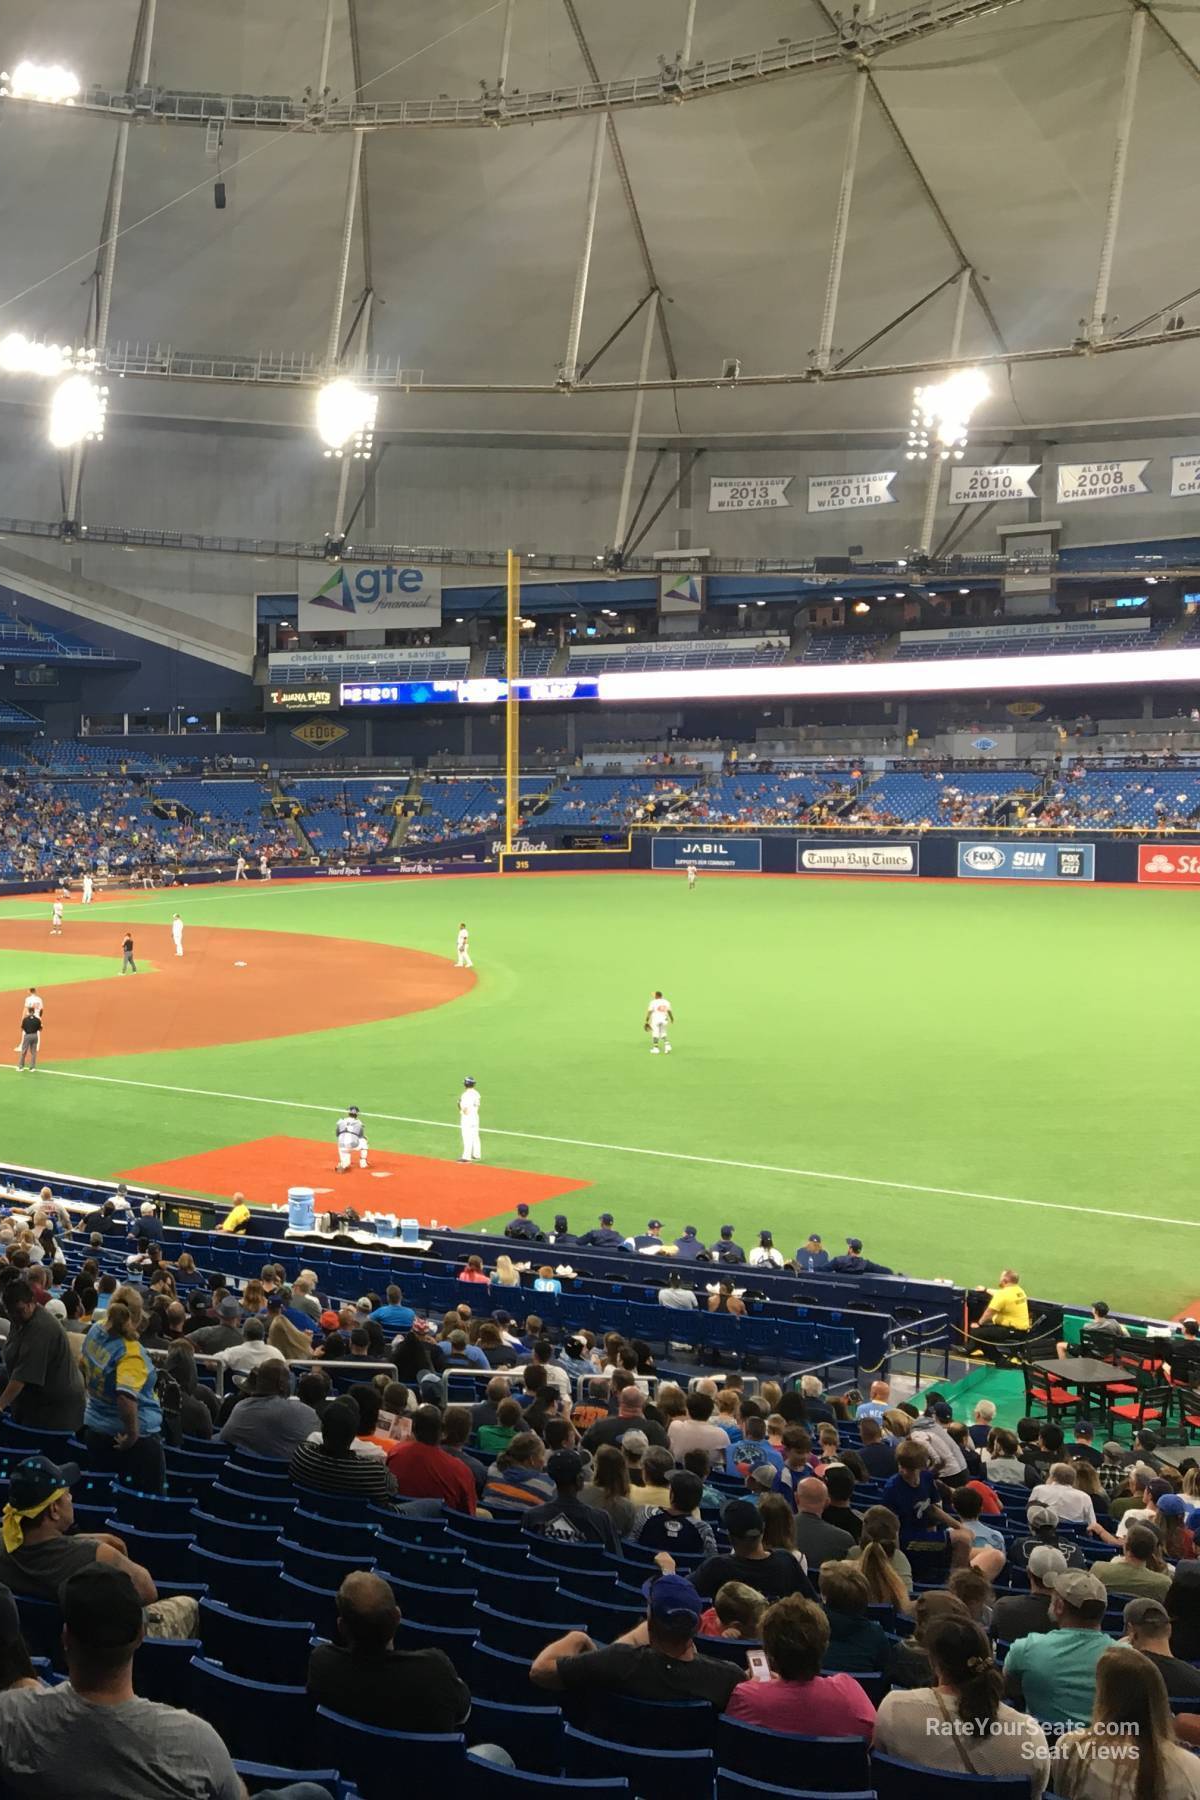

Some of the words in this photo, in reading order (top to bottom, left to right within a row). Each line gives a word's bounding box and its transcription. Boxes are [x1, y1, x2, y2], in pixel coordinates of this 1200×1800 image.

[811, 479, 852, 488] AMERICAN
[856, 475, 889, 483] LEAGUE
[969, 476, 1012, 489] 2010
[1078, 471, 1123, 487] 2008
[730, 487, 769, 500] 2013
[830, 484, 871, 498] 2011
[955, 489, 1023, 499] CHAMPIONS
[1063, 484, 1136, 498] CHAMPIONS
[748, 499, 777, 507] CARD
[818, 500, 845, 508] WILD
[850, 495, 881, 504] CARD
[355, 565, 424, 603] gte
[368, 595, 432, 615] financial
[948, 629, 971, 638] auto
[985, 627, 1017, 636] credit
[1019, 625, 1050, 635] cards
[1065, 622, 1097, 632] home
[625, 644, 652, 653] going
[655, 642, 692, 652] beyond
[695, 640, 729, 650] money
[291, 652, 334, 663] checking
[346, 652, 394, 661] insurance
[408, 649, 447, 660] savings
[303, 726, 337, 739] LEDGE
[492, 840, 520, 854] Had
[682, 844, 729, 854] JABIL
[807, 852, 845, 868] Tampa
[847, 852, 870, 868] Bay
[872, 852, 909, 866] Times
[973, 851, 996, 861] FOX
[1012, 851, 1047, 867] SUN
[1061, 865, 1078, 874] GO
